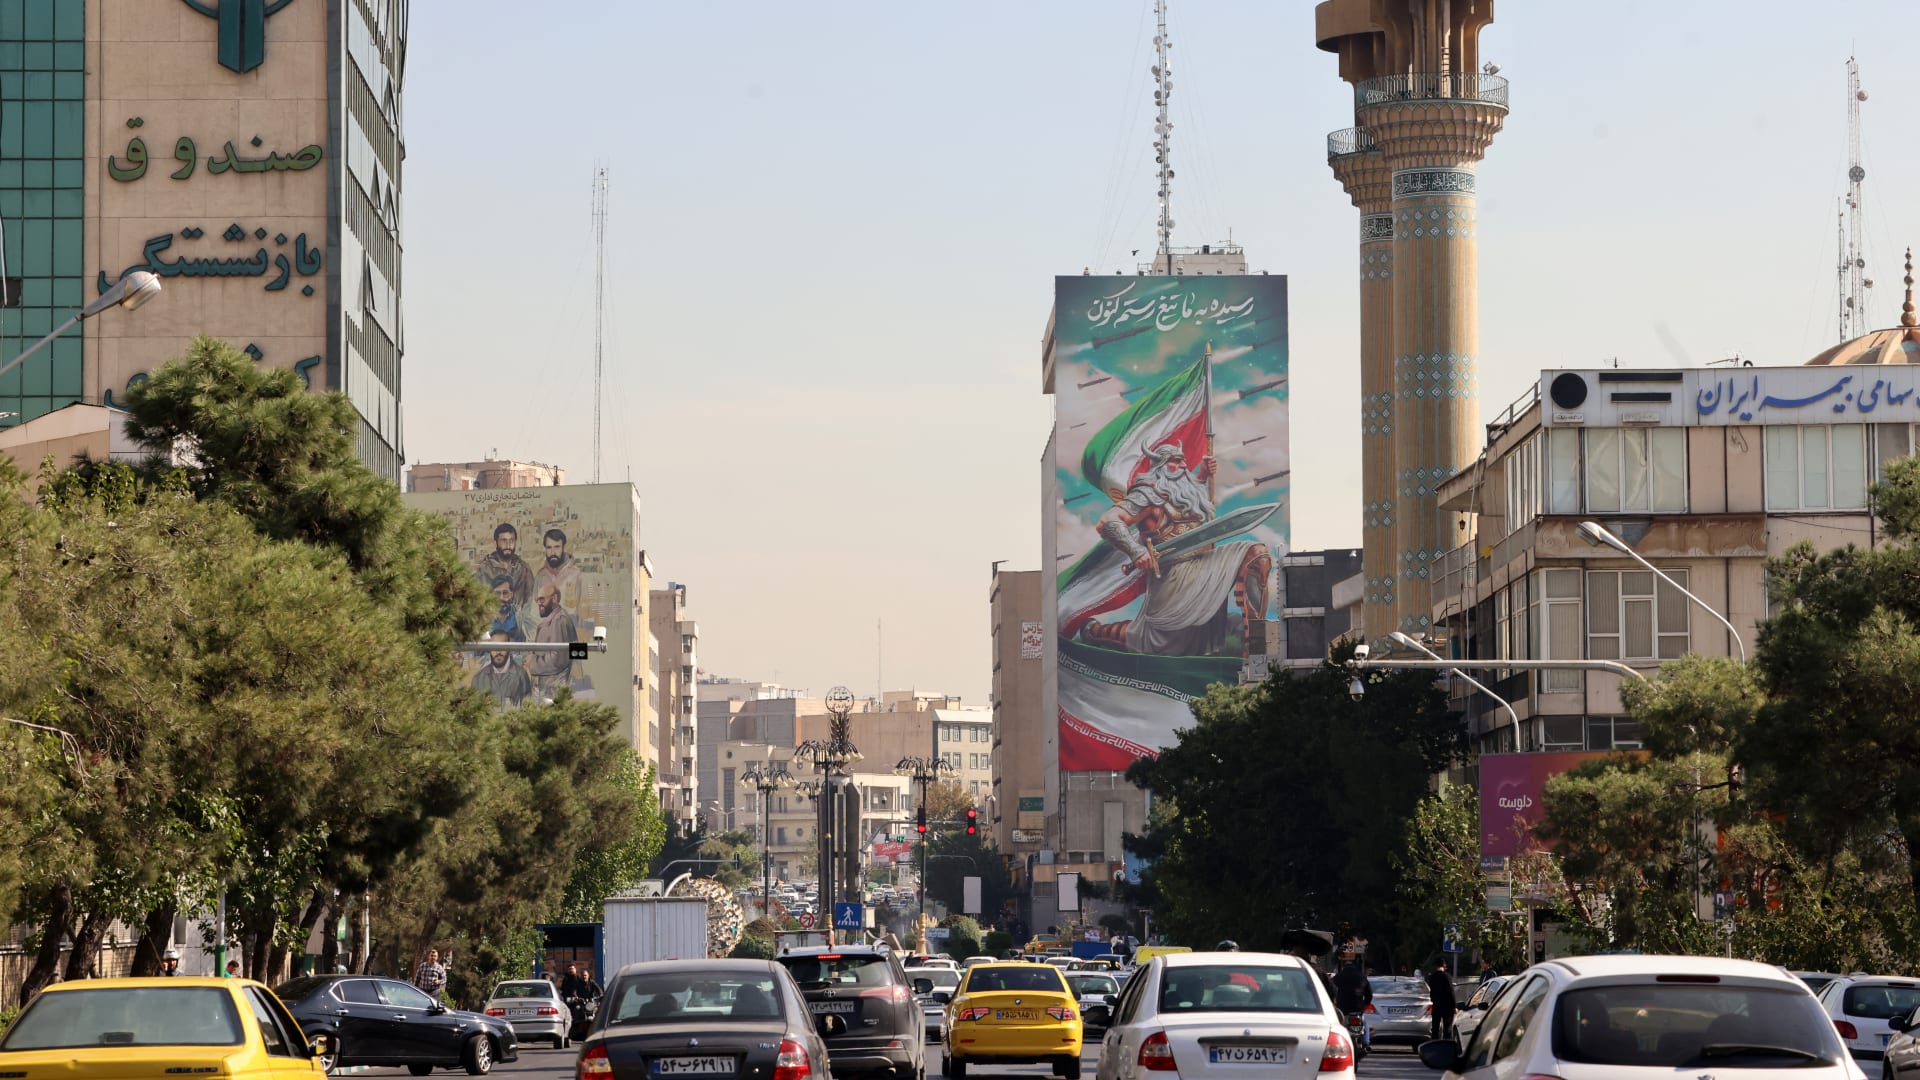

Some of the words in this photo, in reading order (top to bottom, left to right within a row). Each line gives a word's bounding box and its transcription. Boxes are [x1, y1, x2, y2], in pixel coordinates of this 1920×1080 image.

[108, 116, 323, 182] صندوق
[97, 223, 322, 297] بازنشستگی
[1087, 281, 1136, 329] کنون
[1114, 297, 1156, 328] رستم
[1155, 294, 1184, 332] تیغ
[1193, 306, 1208, 325] به
[1208, 296, 1255, 325] رسیده
[1696, 375, 1760, 420] ایران
[1759, 375, 1853, 413] بیمه
[1857, 379, 1914, 413] سهامی
[493, 492, 513, 503] تجاری
[513, 490, 541, 500] ساختمان
[1499, 795, 1532, 811] دلوسه
